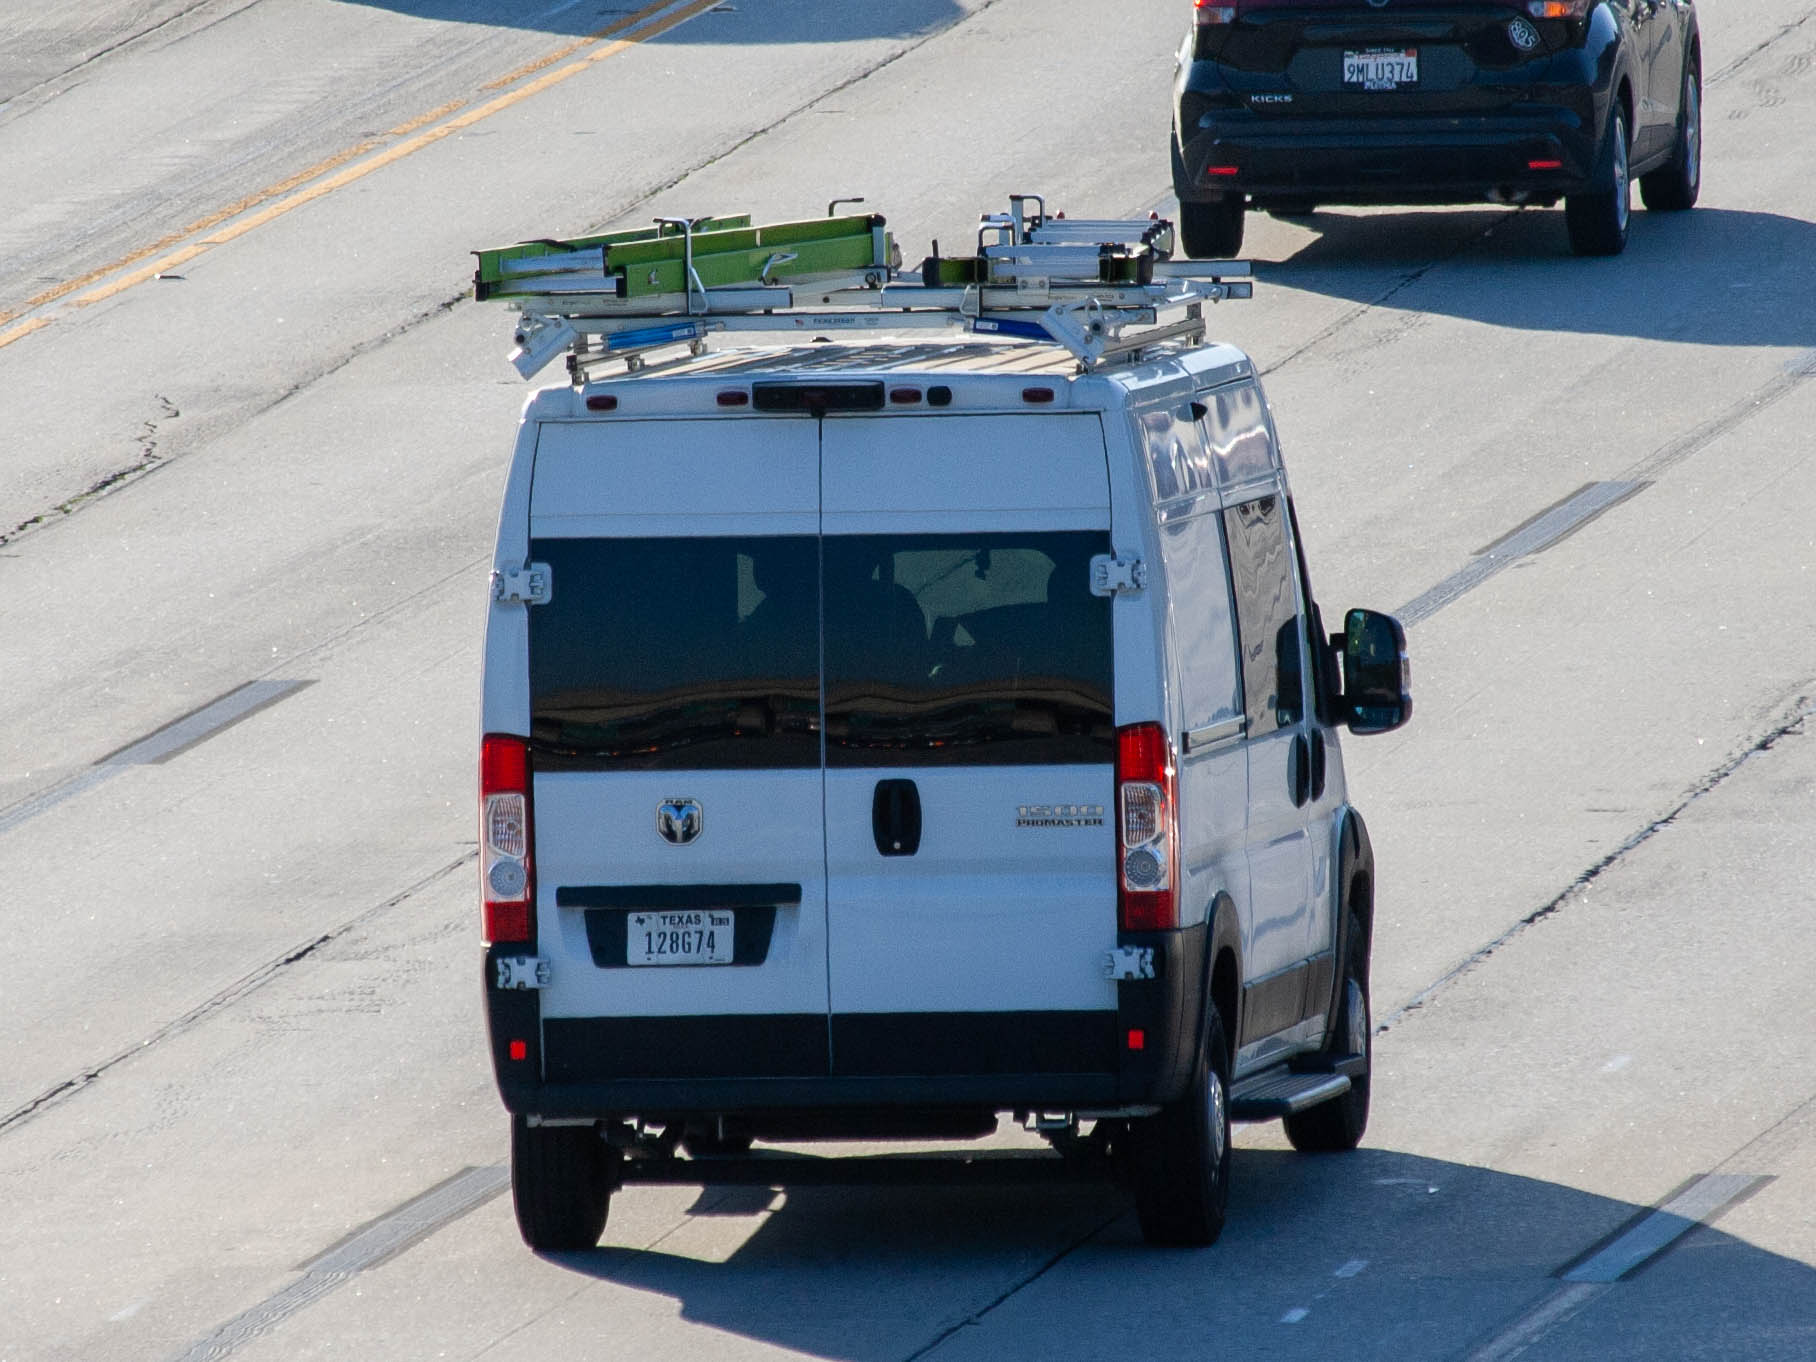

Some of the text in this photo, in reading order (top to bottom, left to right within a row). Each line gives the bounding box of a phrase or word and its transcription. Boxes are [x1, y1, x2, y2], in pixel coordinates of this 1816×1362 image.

[1511, 20, 1536, 47] 805
[1347, 62, 1414, 81] 9MLU374
[1251, 95, 1293, 103] KICKS
[1016, 805, 1104, 817] 1500
[1016, 818, 1104, 827] PROMASTER
[660, 914, 702, 926] TEXAS
[645, 930, 716, 955] 128G74
